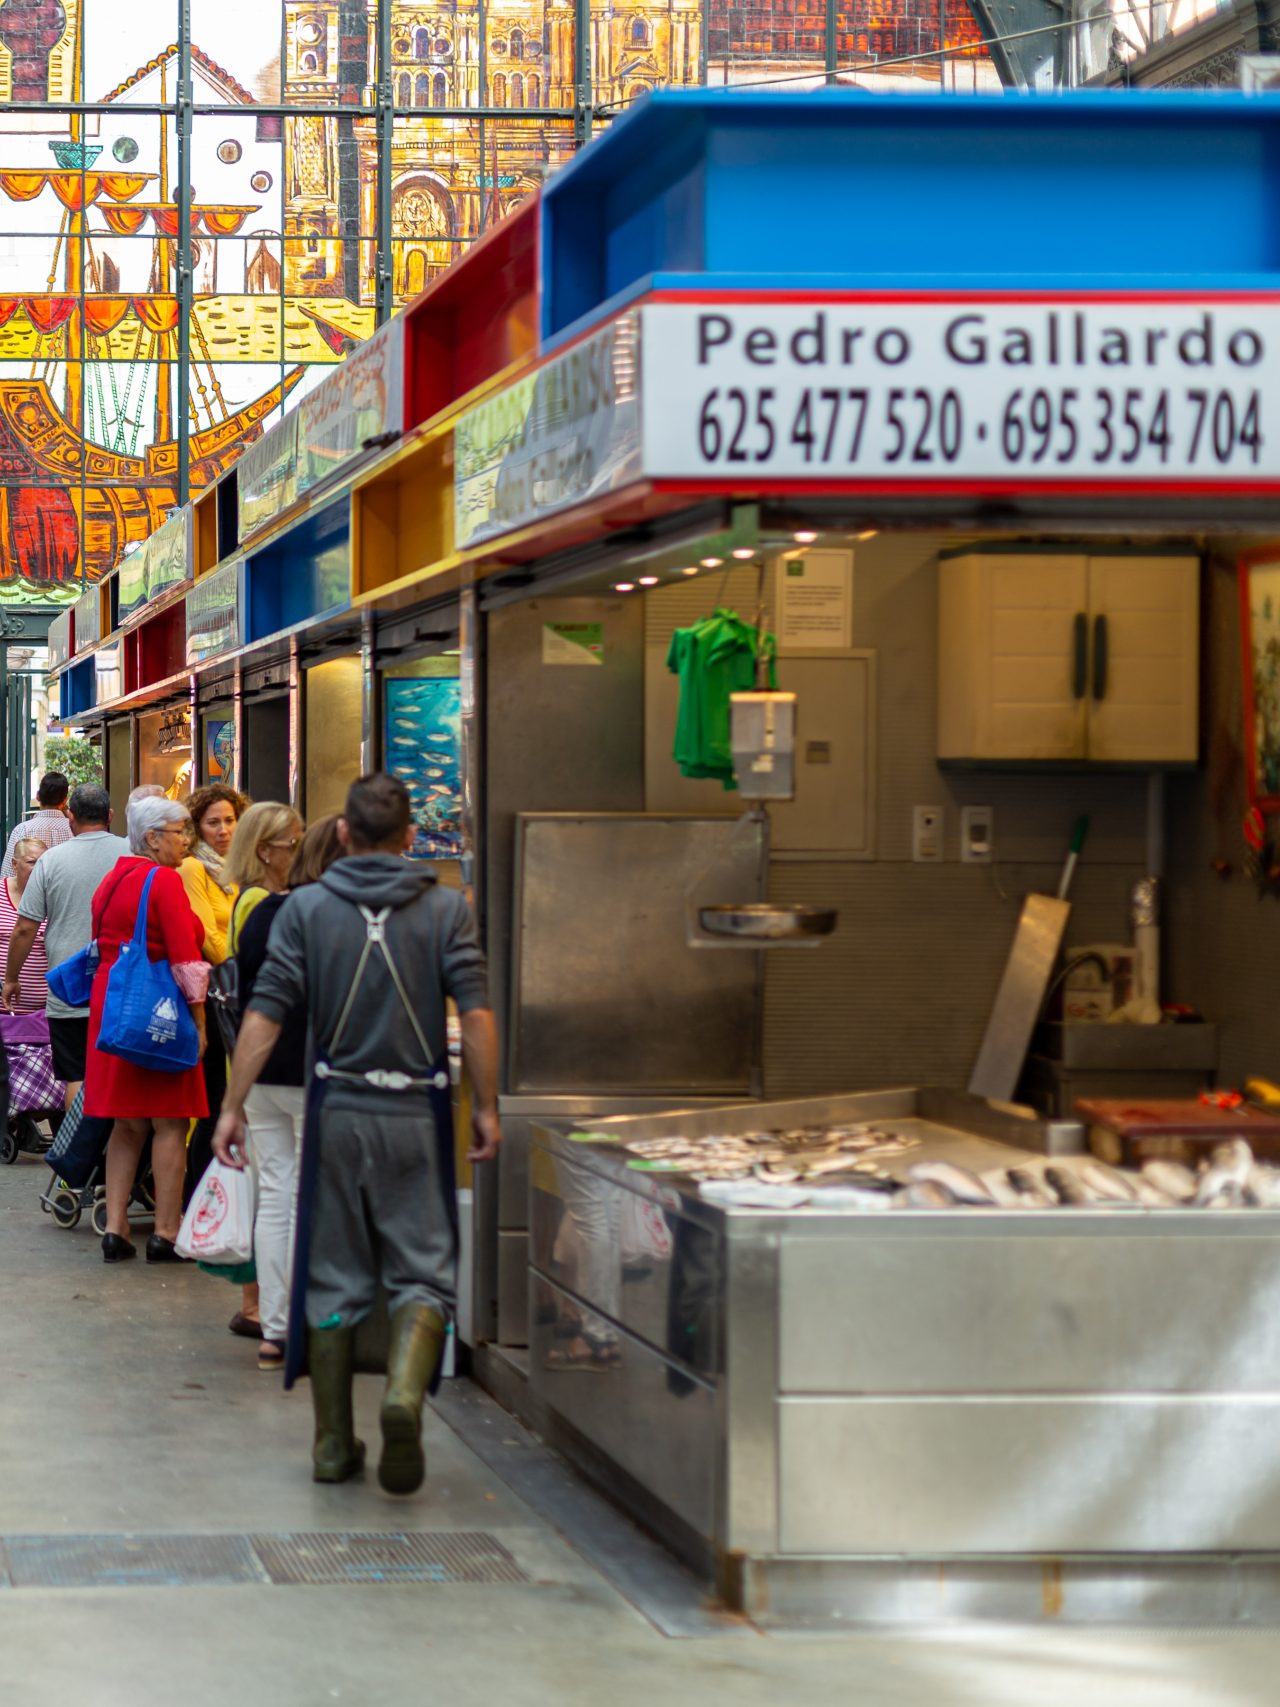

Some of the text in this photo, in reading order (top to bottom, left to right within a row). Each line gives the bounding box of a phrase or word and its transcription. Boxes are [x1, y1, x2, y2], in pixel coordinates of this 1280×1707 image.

[696, 310, 1266, 368] Pedro Gallardo
[697, 387, 776, 464] 625
[791, 387, 870, 464] 477
[883, 387, 963, 464] 520
[1000, 387, 1078, 464] 695
[1093, 387, 1170, 464] 354
[1186, 387, 1263, 465] 704
